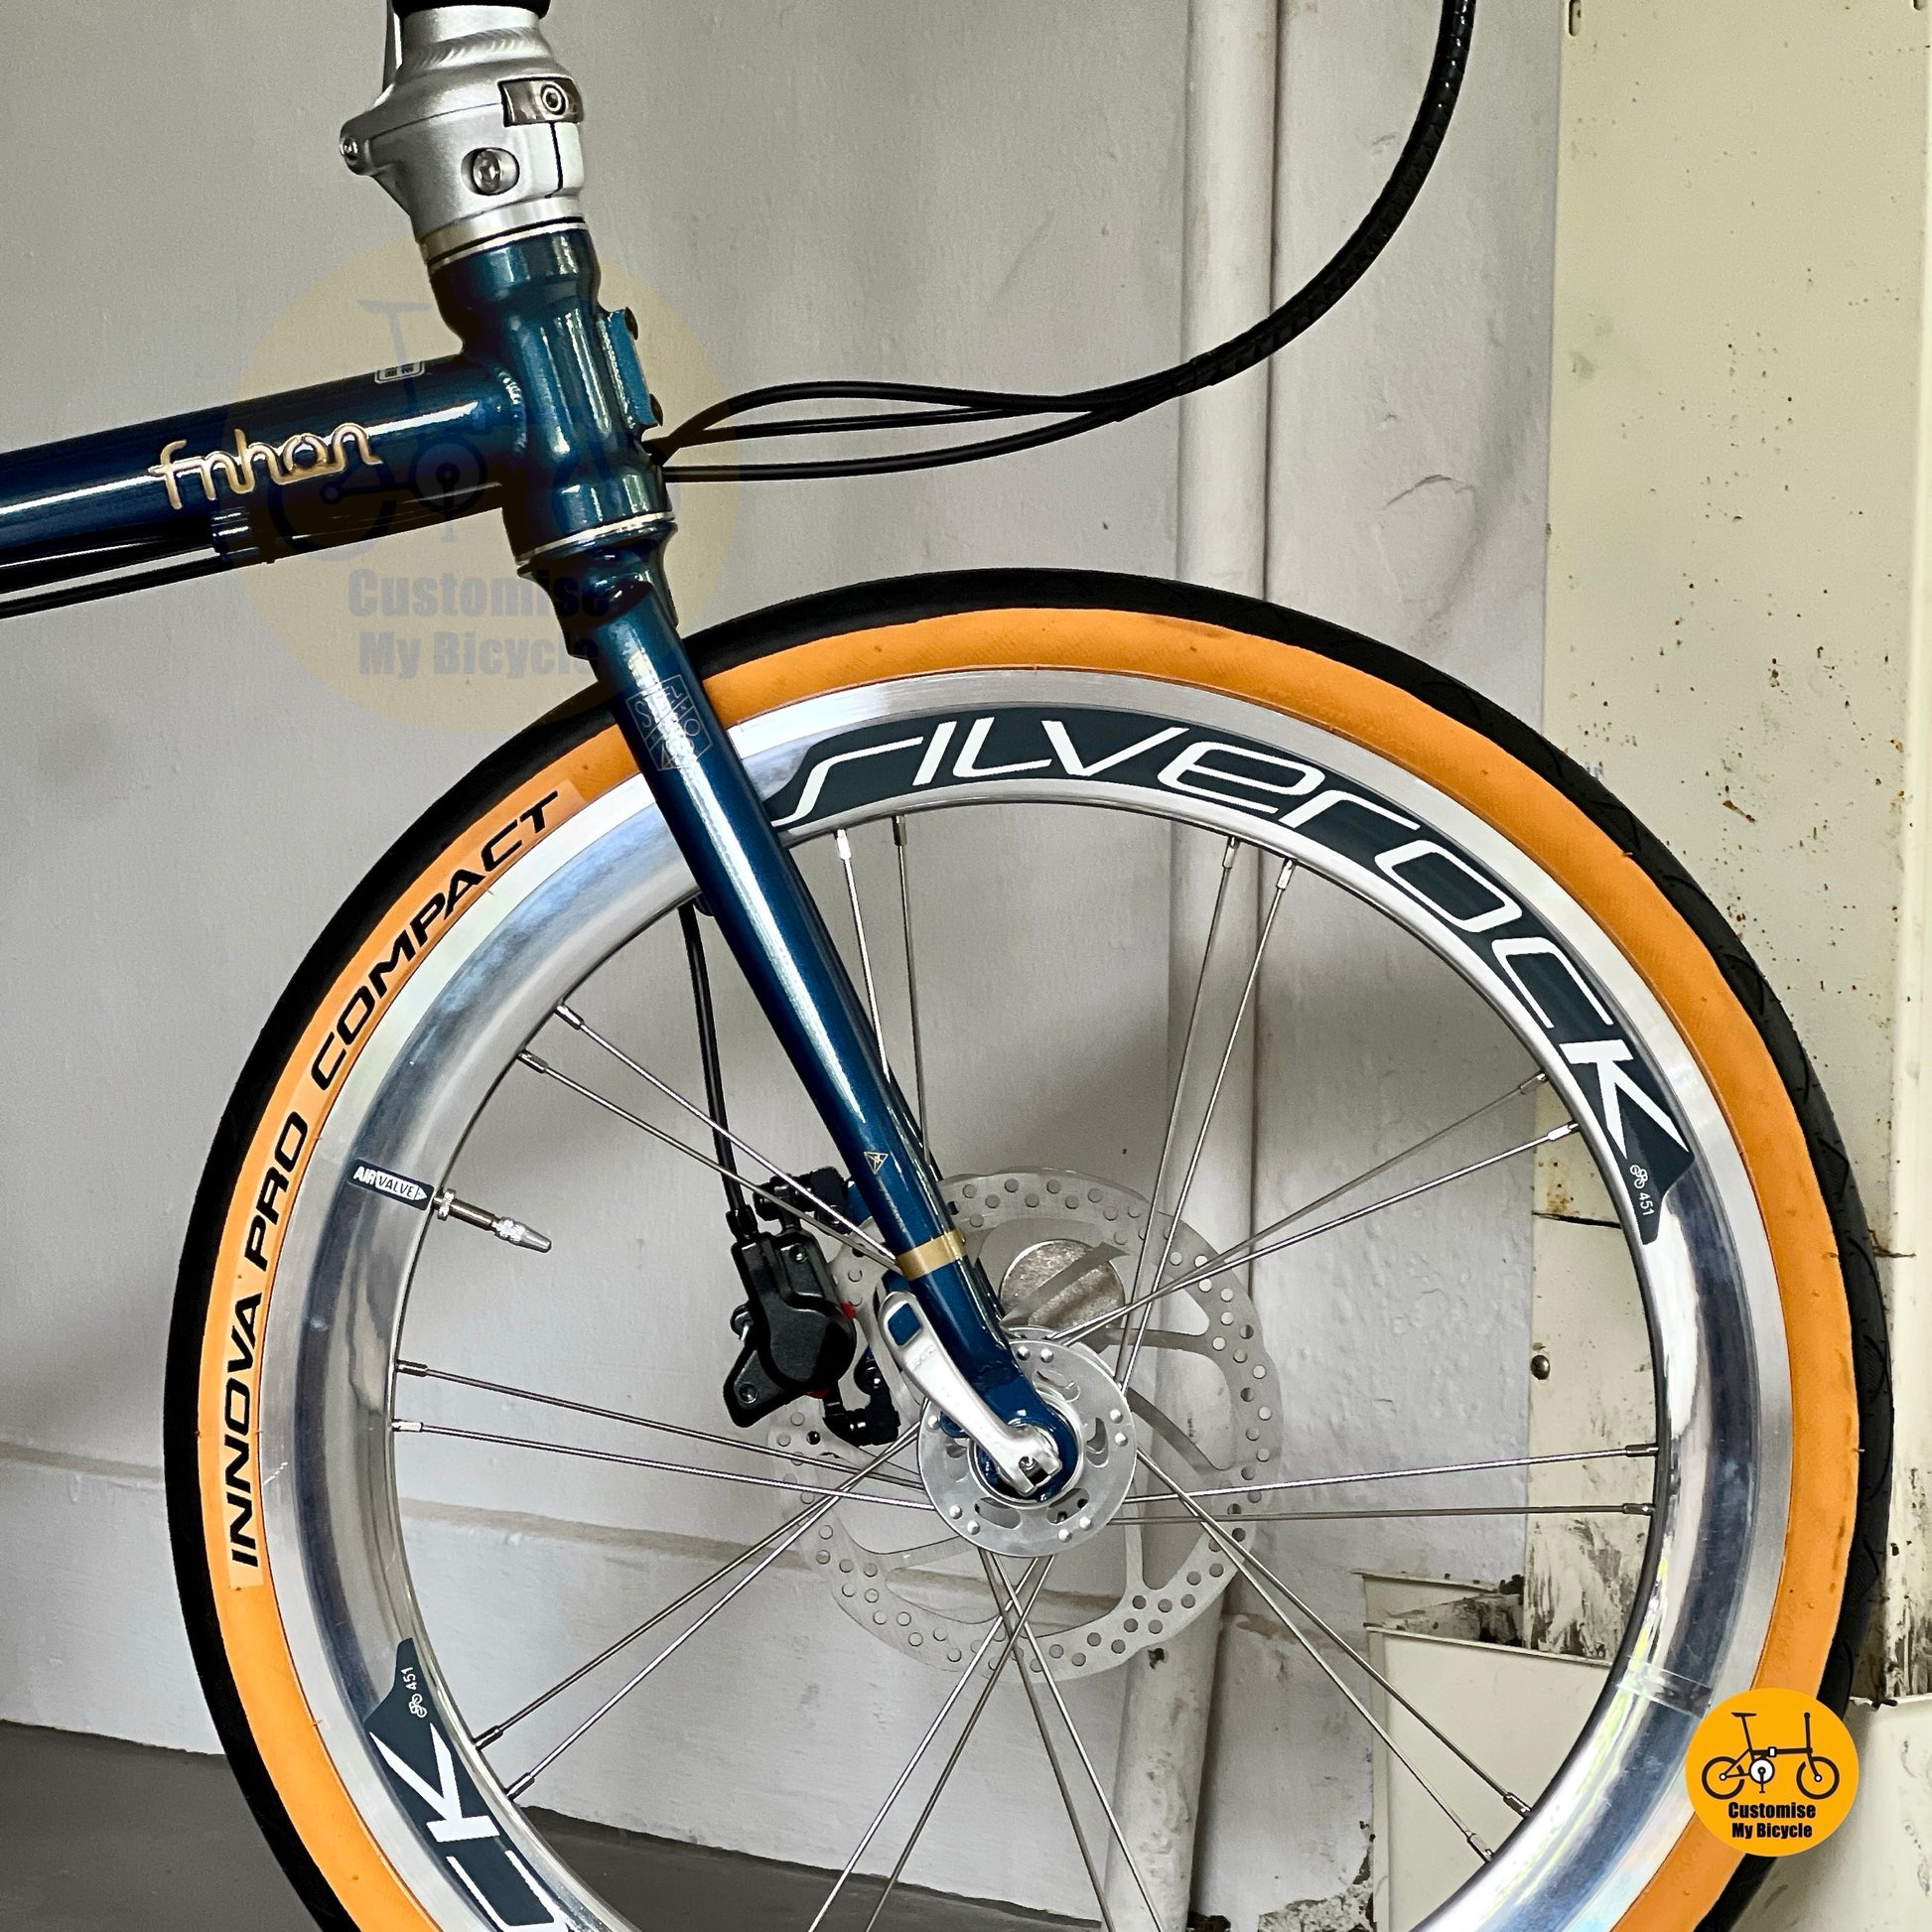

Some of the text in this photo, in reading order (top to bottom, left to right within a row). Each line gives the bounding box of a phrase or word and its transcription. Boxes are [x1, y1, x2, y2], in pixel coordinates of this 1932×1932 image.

[148, 422, 383, 509] fnhon
[224, 790, 558, 1568] INNOVA PRO COMPACT
[1639, 1192, 1655, 1215] 451
[401, 1666, 417, 1691] 451
